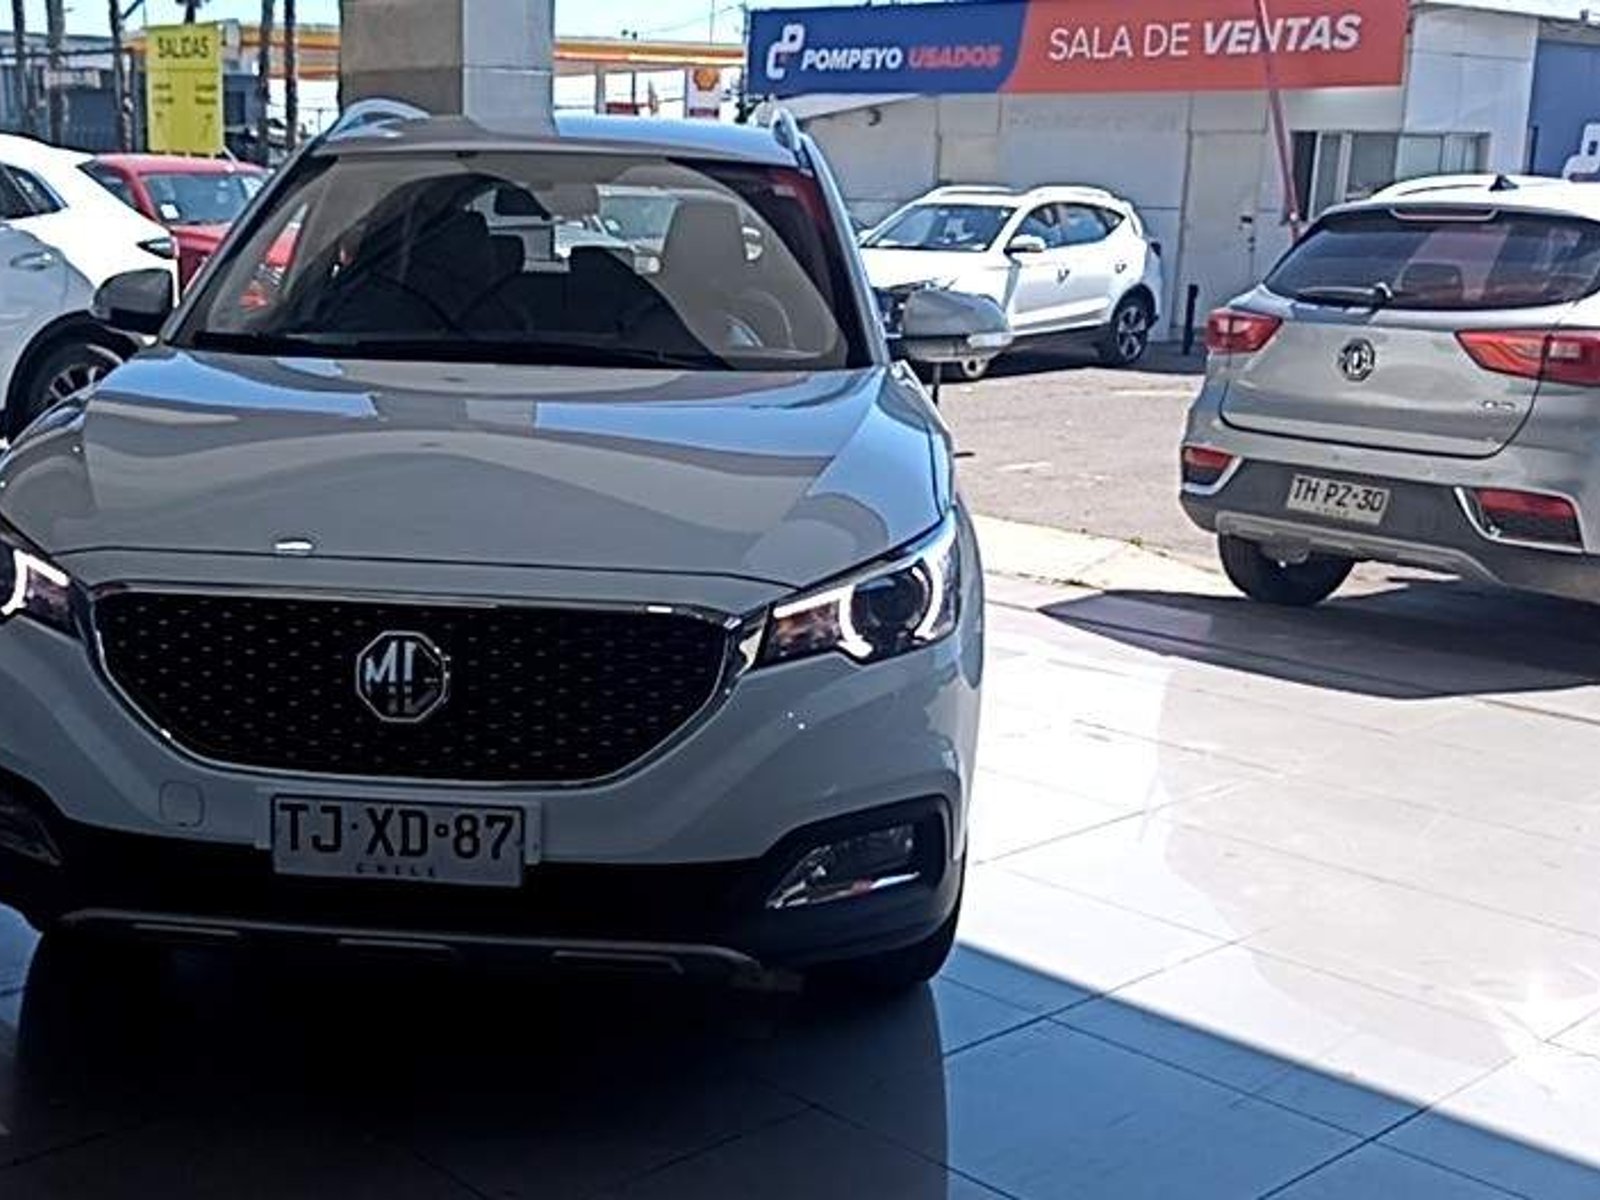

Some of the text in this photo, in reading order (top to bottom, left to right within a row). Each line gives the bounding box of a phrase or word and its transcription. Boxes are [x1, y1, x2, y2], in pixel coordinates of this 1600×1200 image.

[1049, 14, 1362, 61] SALA DE VENTAS
[801, 46, 1003, 71] POMPEYO USADOS
